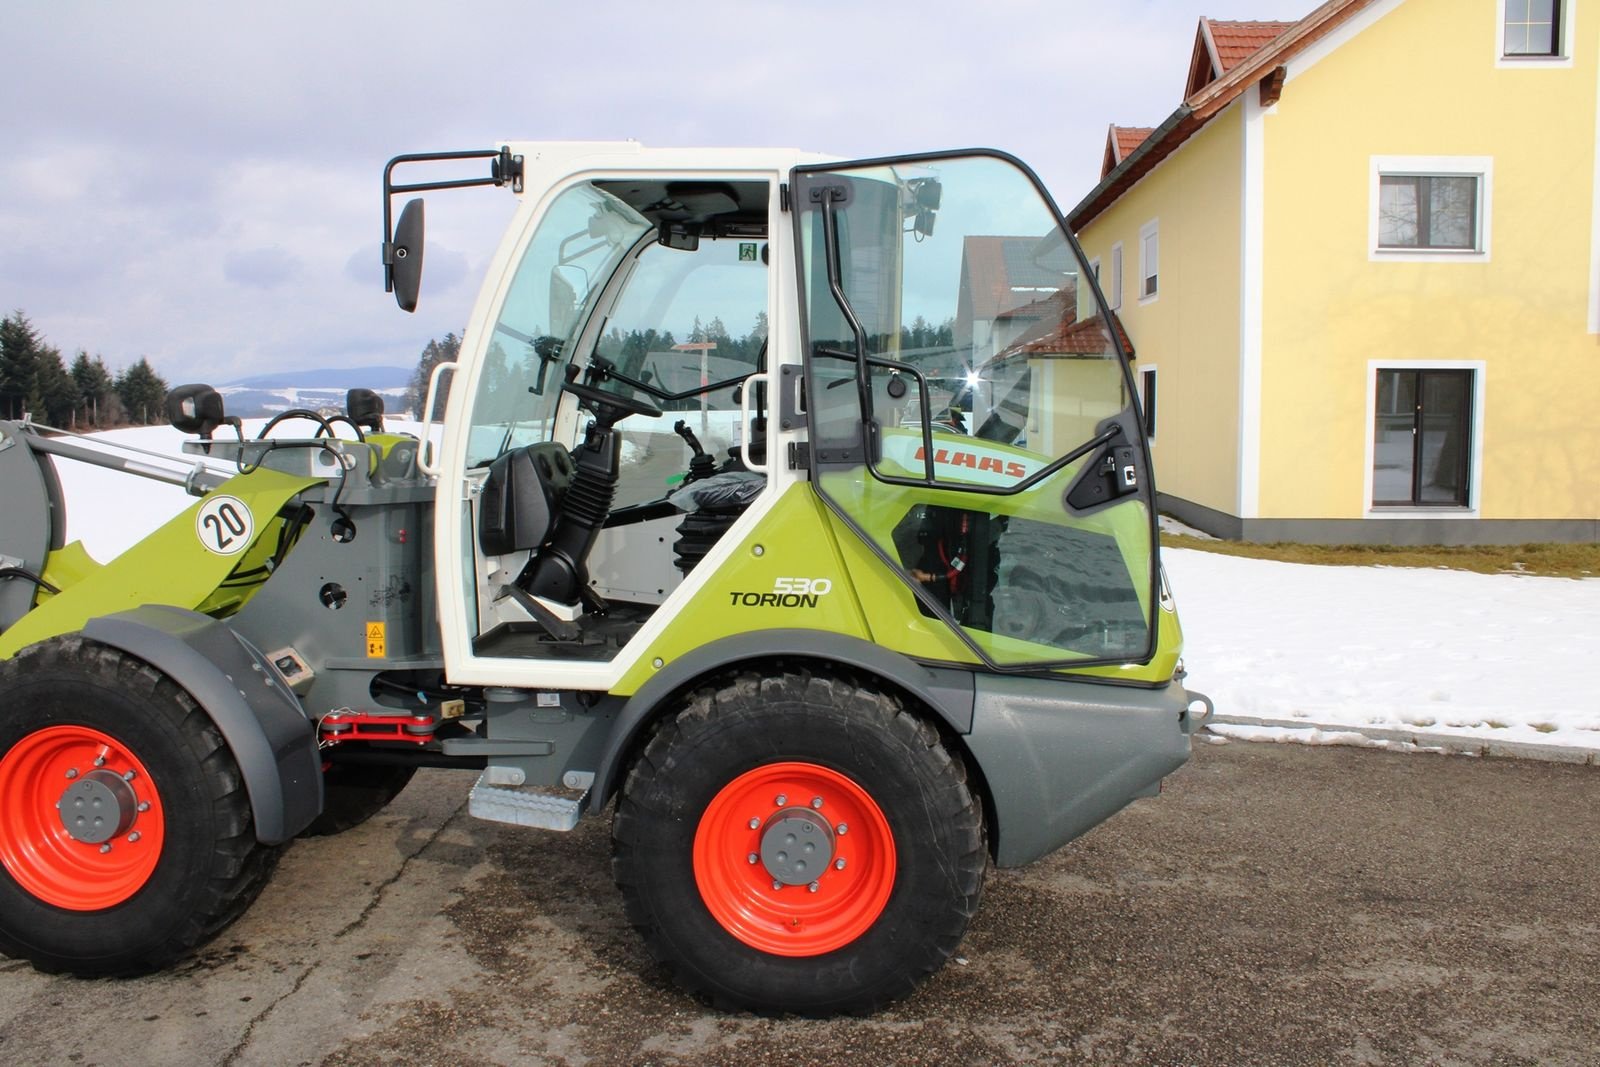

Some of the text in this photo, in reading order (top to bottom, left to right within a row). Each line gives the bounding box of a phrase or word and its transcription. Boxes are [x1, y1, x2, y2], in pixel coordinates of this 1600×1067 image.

[203, 503, 246, 549] 20
[773, 577, 832, 595] 530
[730, 592, 819, 608] TORION
